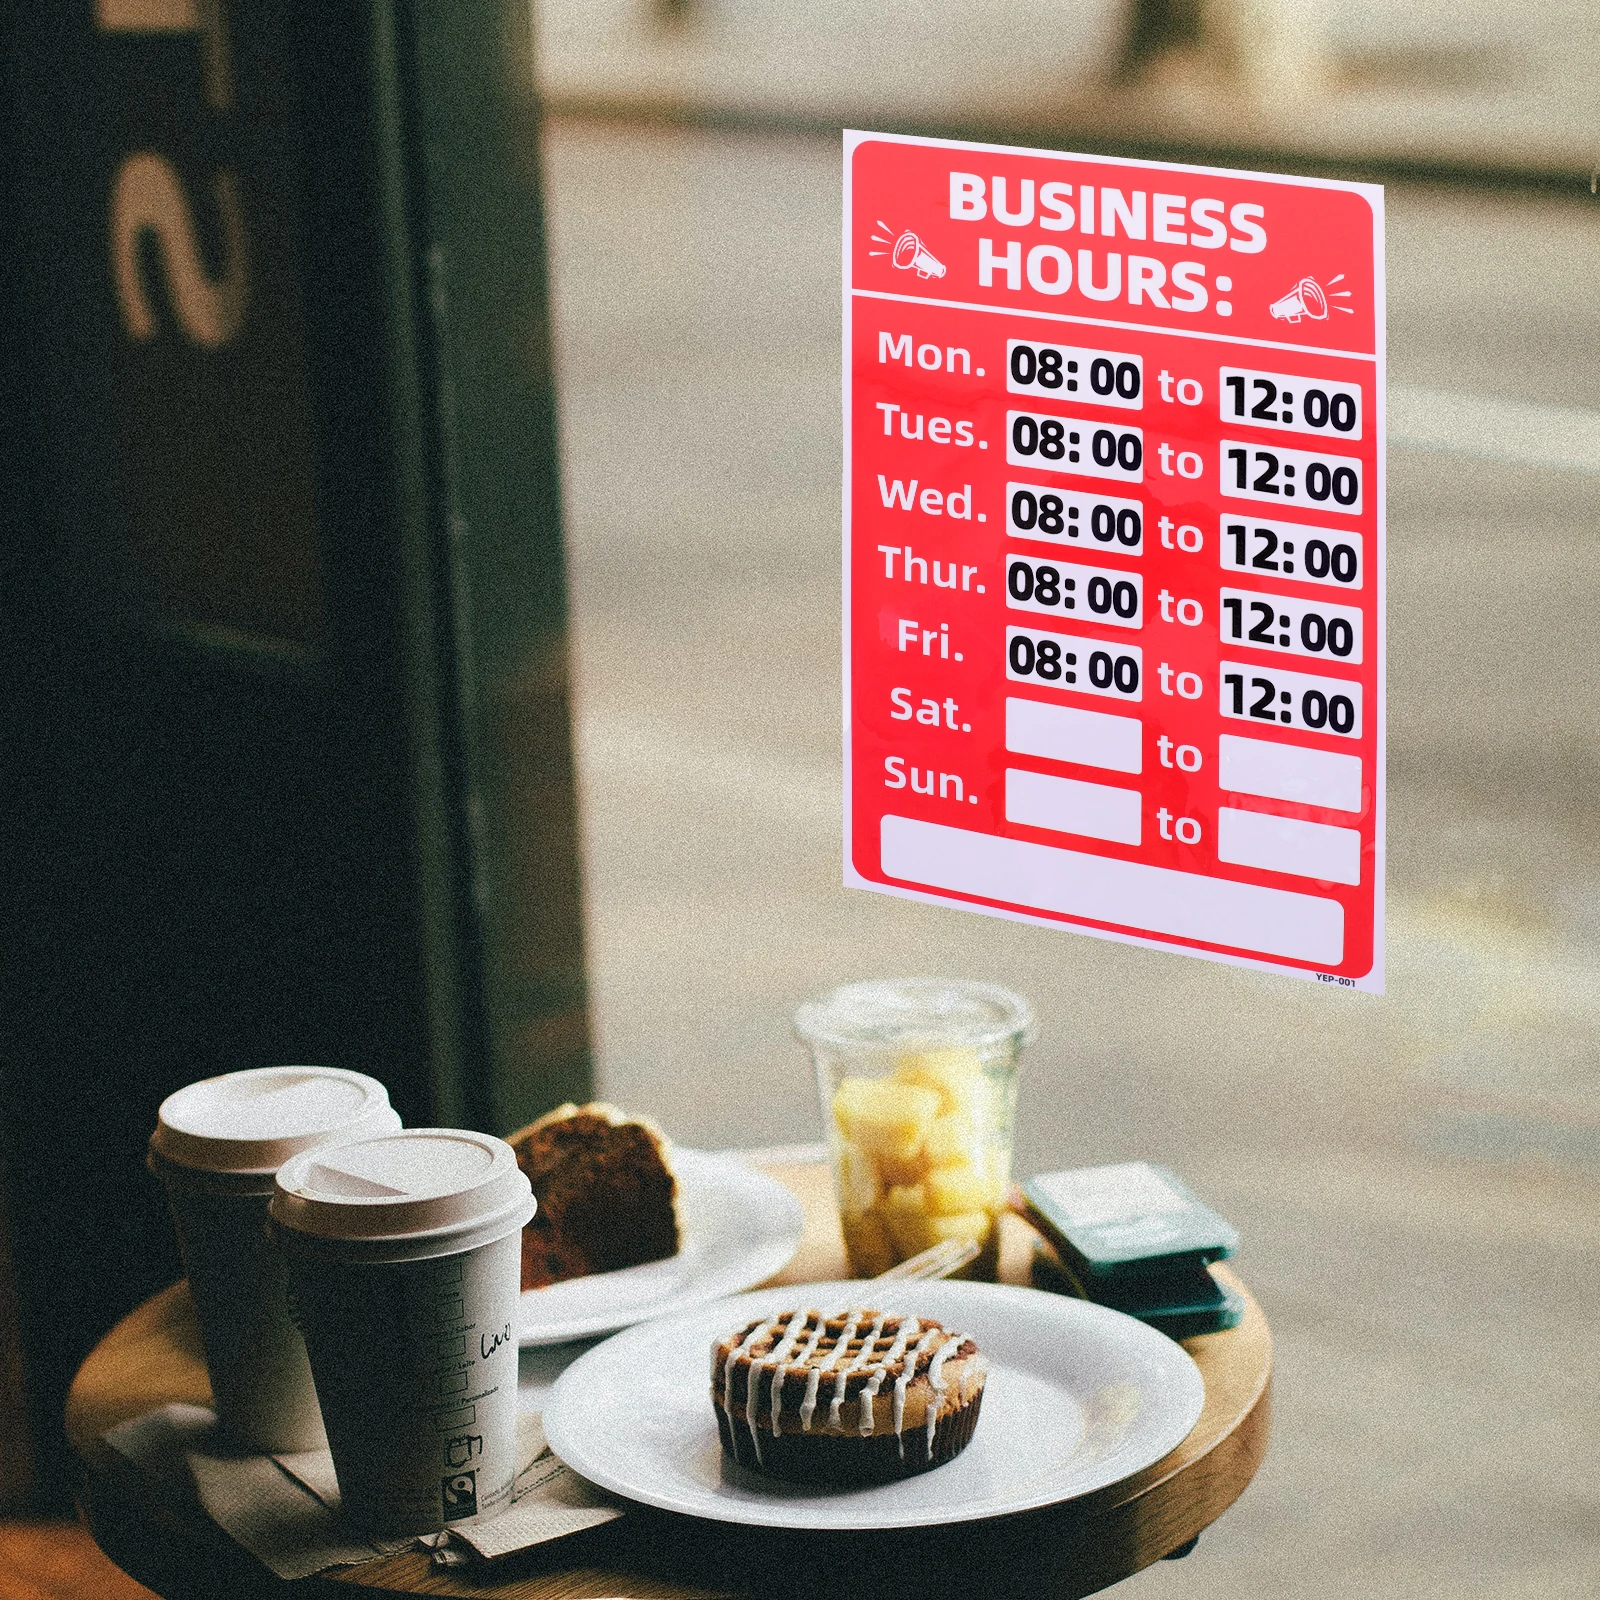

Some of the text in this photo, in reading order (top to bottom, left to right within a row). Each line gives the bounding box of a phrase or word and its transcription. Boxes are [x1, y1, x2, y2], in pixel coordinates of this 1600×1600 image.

[949, 171, 1268, 254] BUSINESS
[978, 237, 1233, 317] HOURS:
[879, 332, 985, 376] Mon.
[1157, 369, 1204, 406] to
[876, 401, 988, 450] Tues.
[1157, 442, 1204, 479] to
[878, 475, 987, 523] Wed.
[1157, 515, 1204, 553] to
[878, 544, 986, 594] Thur.
[1157, 589, 1204, 627] to
[898, 618, 964, 662] Fri.
[1157, 662, 1203, 700] to
[890, 687, 1203, 773] Sat. to
[884, 756, 1202, 845] Sun. to
[1315, 972, 1356, 988] YEP-001
